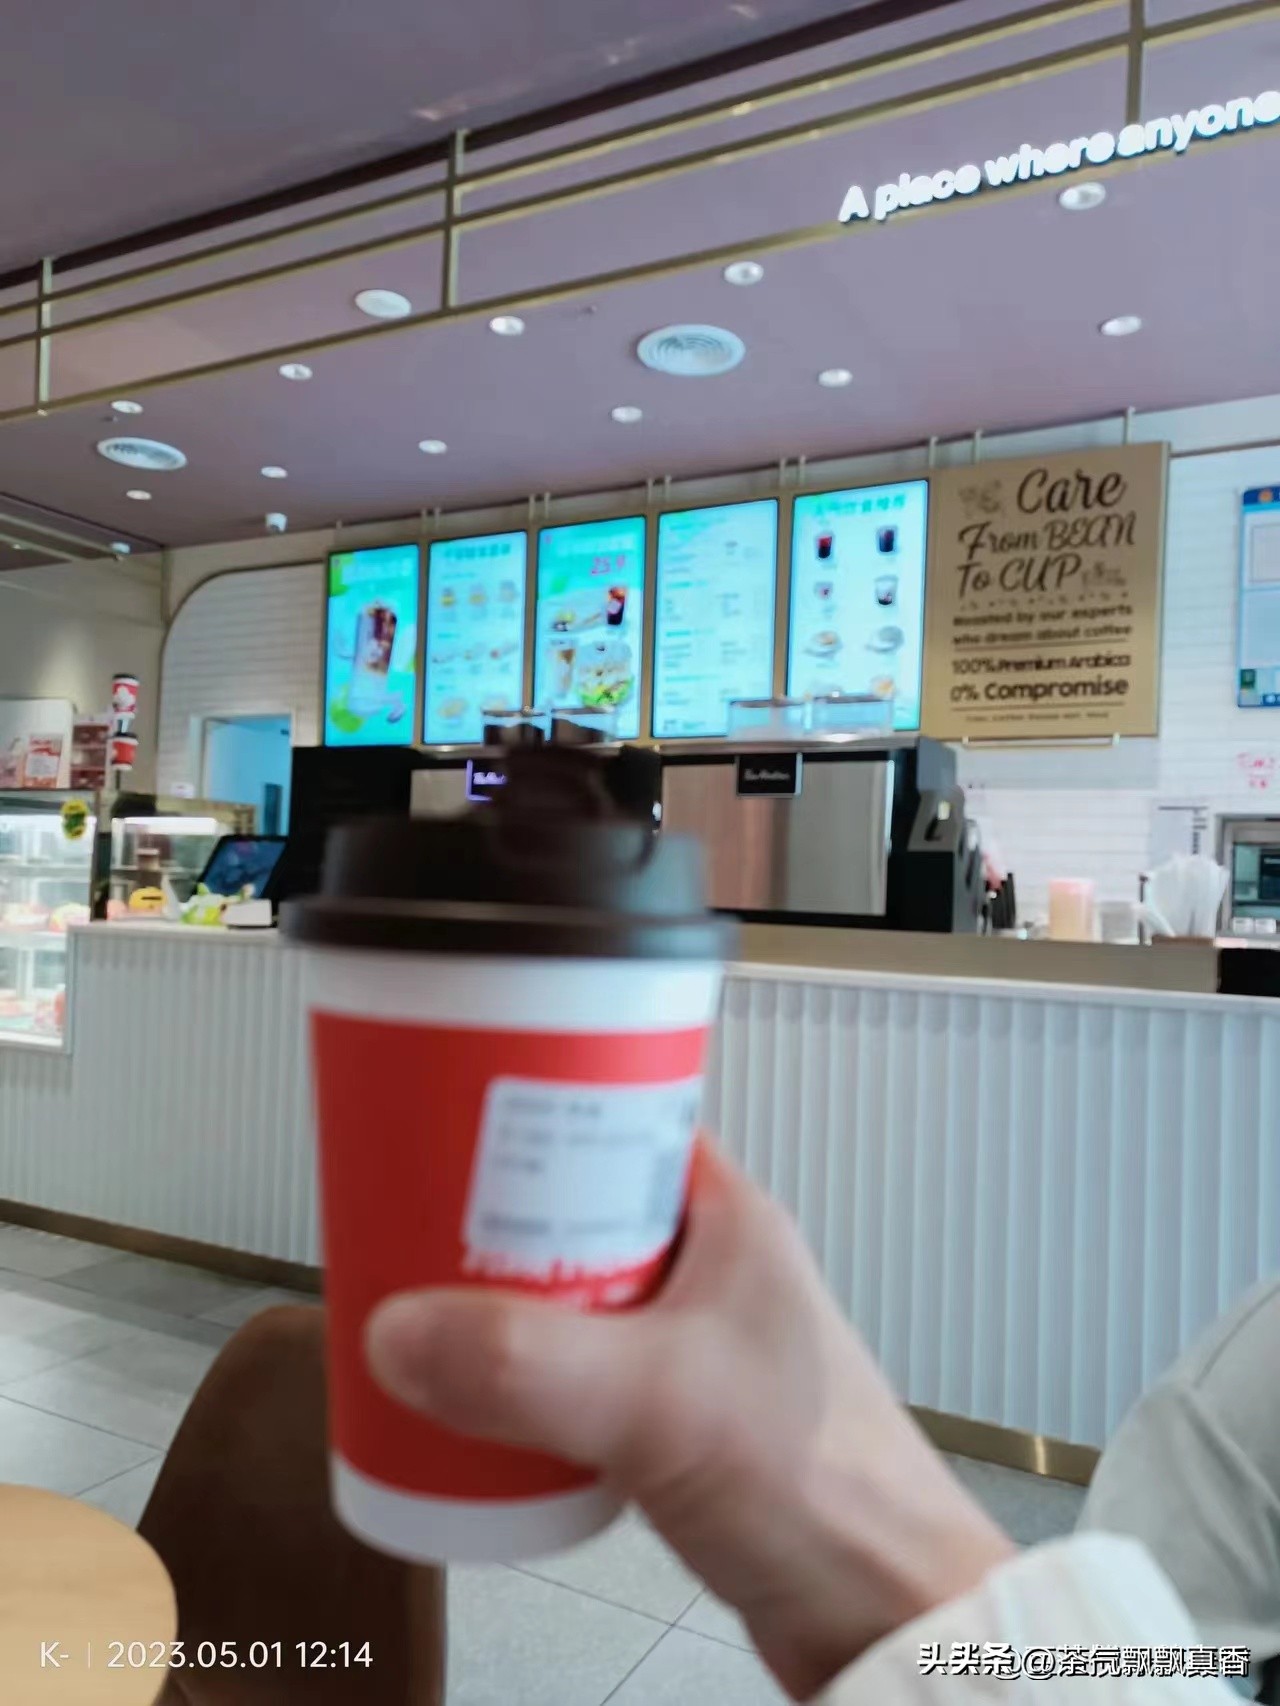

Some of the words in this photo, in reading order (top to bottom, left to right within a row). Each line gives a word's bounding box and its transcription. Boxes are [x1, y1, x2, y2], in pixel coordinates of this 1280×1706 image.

[838, 185, 870, 223] A
[873, 164, 982, 222] place
[984, 131, 1116, 187] where
[1115, 90, 1280, 154] anyone
[1017, 467, 1128, 514] Care
[958, 521, 1038, 561] From
[1043, 510, 1137, 551] BEAN
[956, 562, 991, 598] To
[999, 552, 1083, 592] CUP
[1071, 604, 1133, 620] experts
[1084, 624, 1132, 638] coffee
[952, 657, 997, 674] 100%
[1069, 650, 1131, 668] Arabica
[950, 684, 979, 702] 0%
[984, 674, 1129, 702] Compromise
